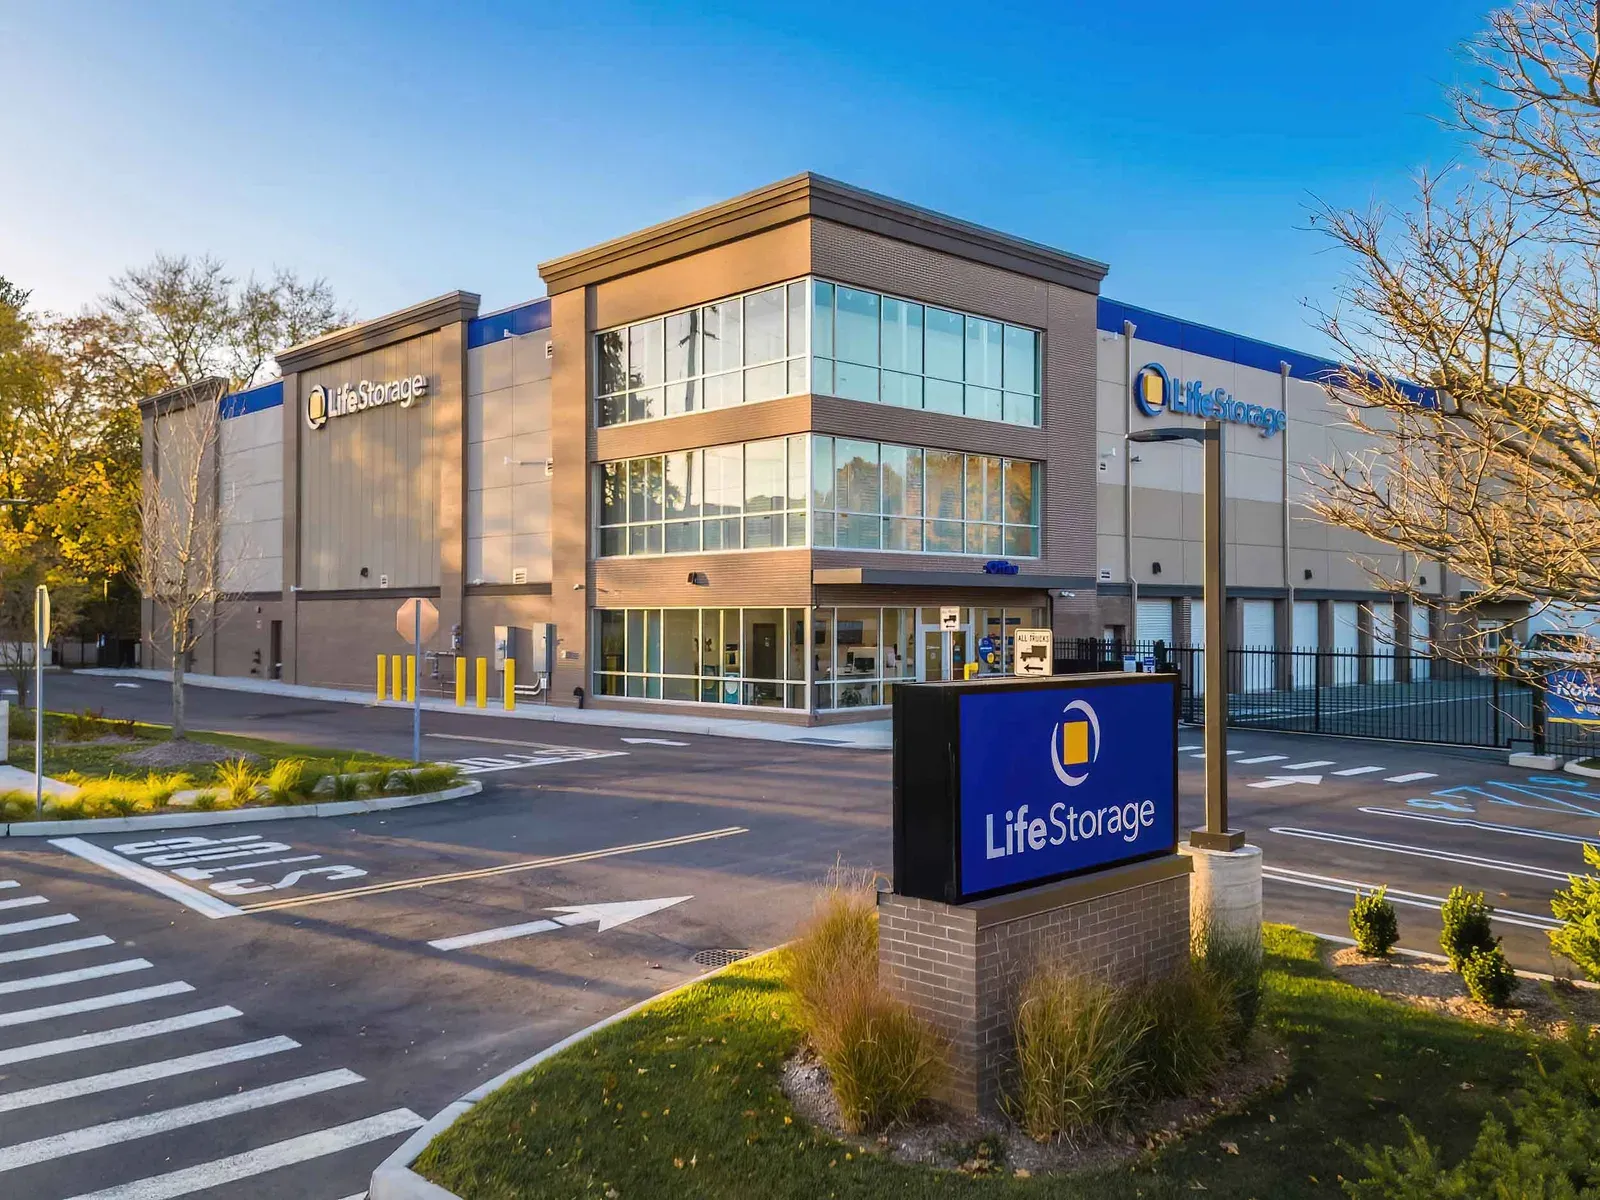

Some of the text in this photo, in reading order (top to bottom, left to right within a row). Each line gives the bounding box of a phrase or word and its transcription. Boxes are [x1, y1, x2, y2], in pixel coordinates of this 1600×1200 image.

[1018, 634, 1049, 643] ALL TRUCKS
[113, 834, 368, 895] STOP
